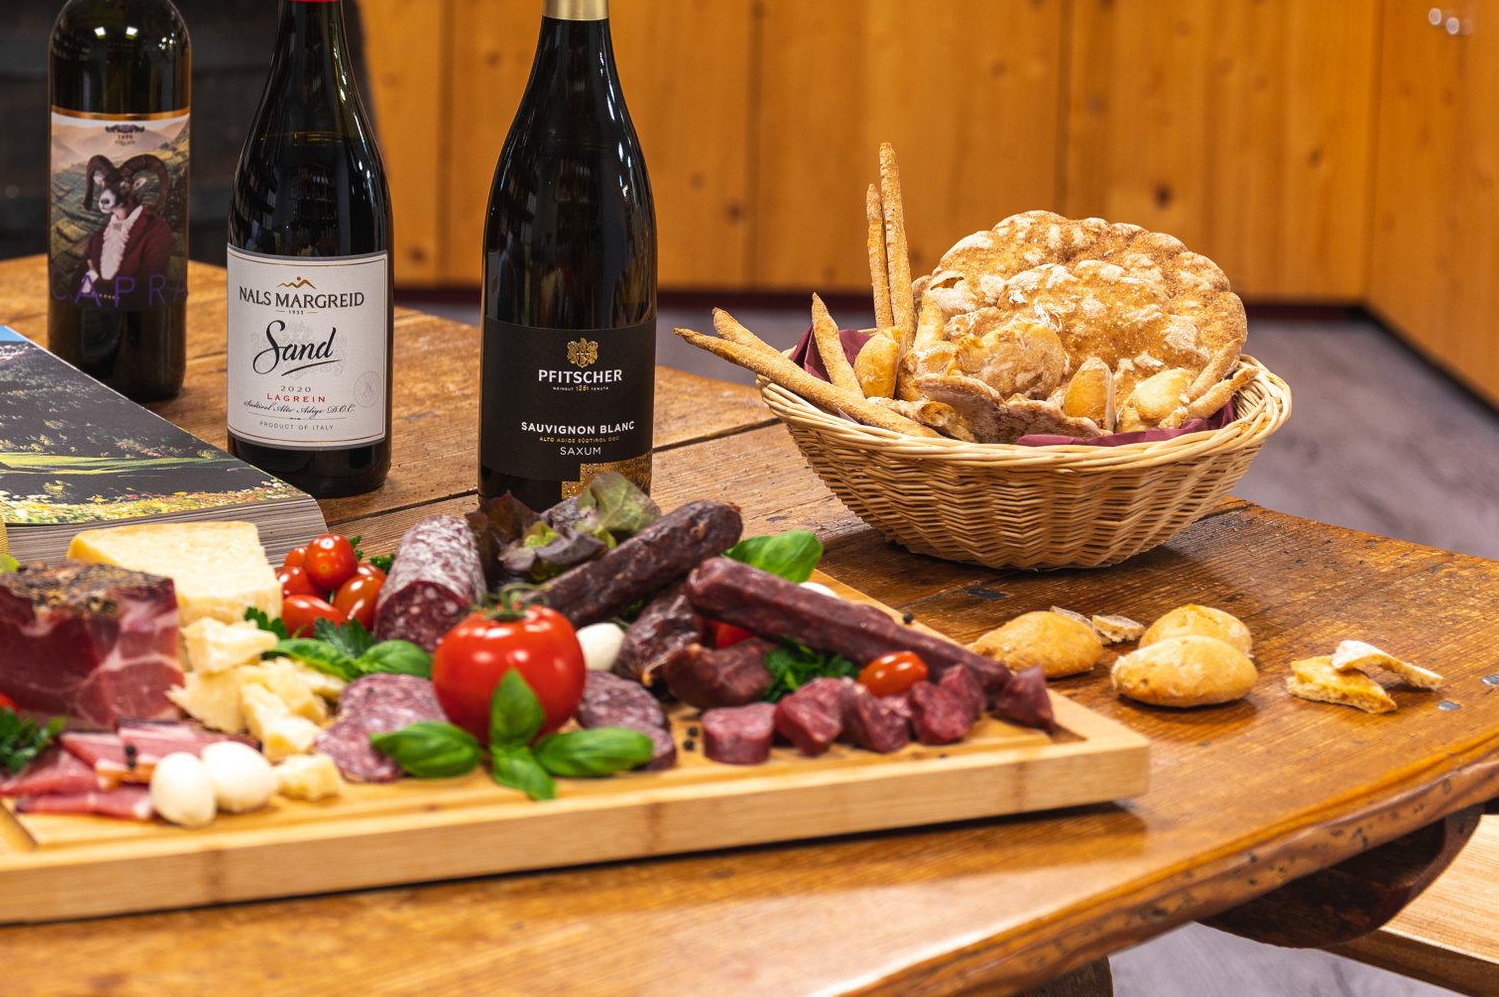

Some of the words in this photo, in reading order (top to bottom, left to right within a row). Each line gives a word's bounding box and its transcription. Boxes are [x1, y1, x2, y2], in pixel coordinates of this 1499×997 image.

[50, 267, 187, 308] CAPRA
[239, 286, 271, 306] NALS
[275, 291, 365, 309] MARGREID
[252, 319, 337, 376] Sand
[538, 369, 623, 383] PFITSCHER
[280, 385, 312, 393] 2020
[266, 393, 326, 403] LAGREIN
[273, 404, 294, 413] Alto
[296, 406, 325, 419] Adige
[259, 420, 294, 430] PRODUCT
[521, 421, 596, 435] SAUVIGNON
[600, 420, 635, 434] BLANC
[560, 446, 601, 456] SAXUM
